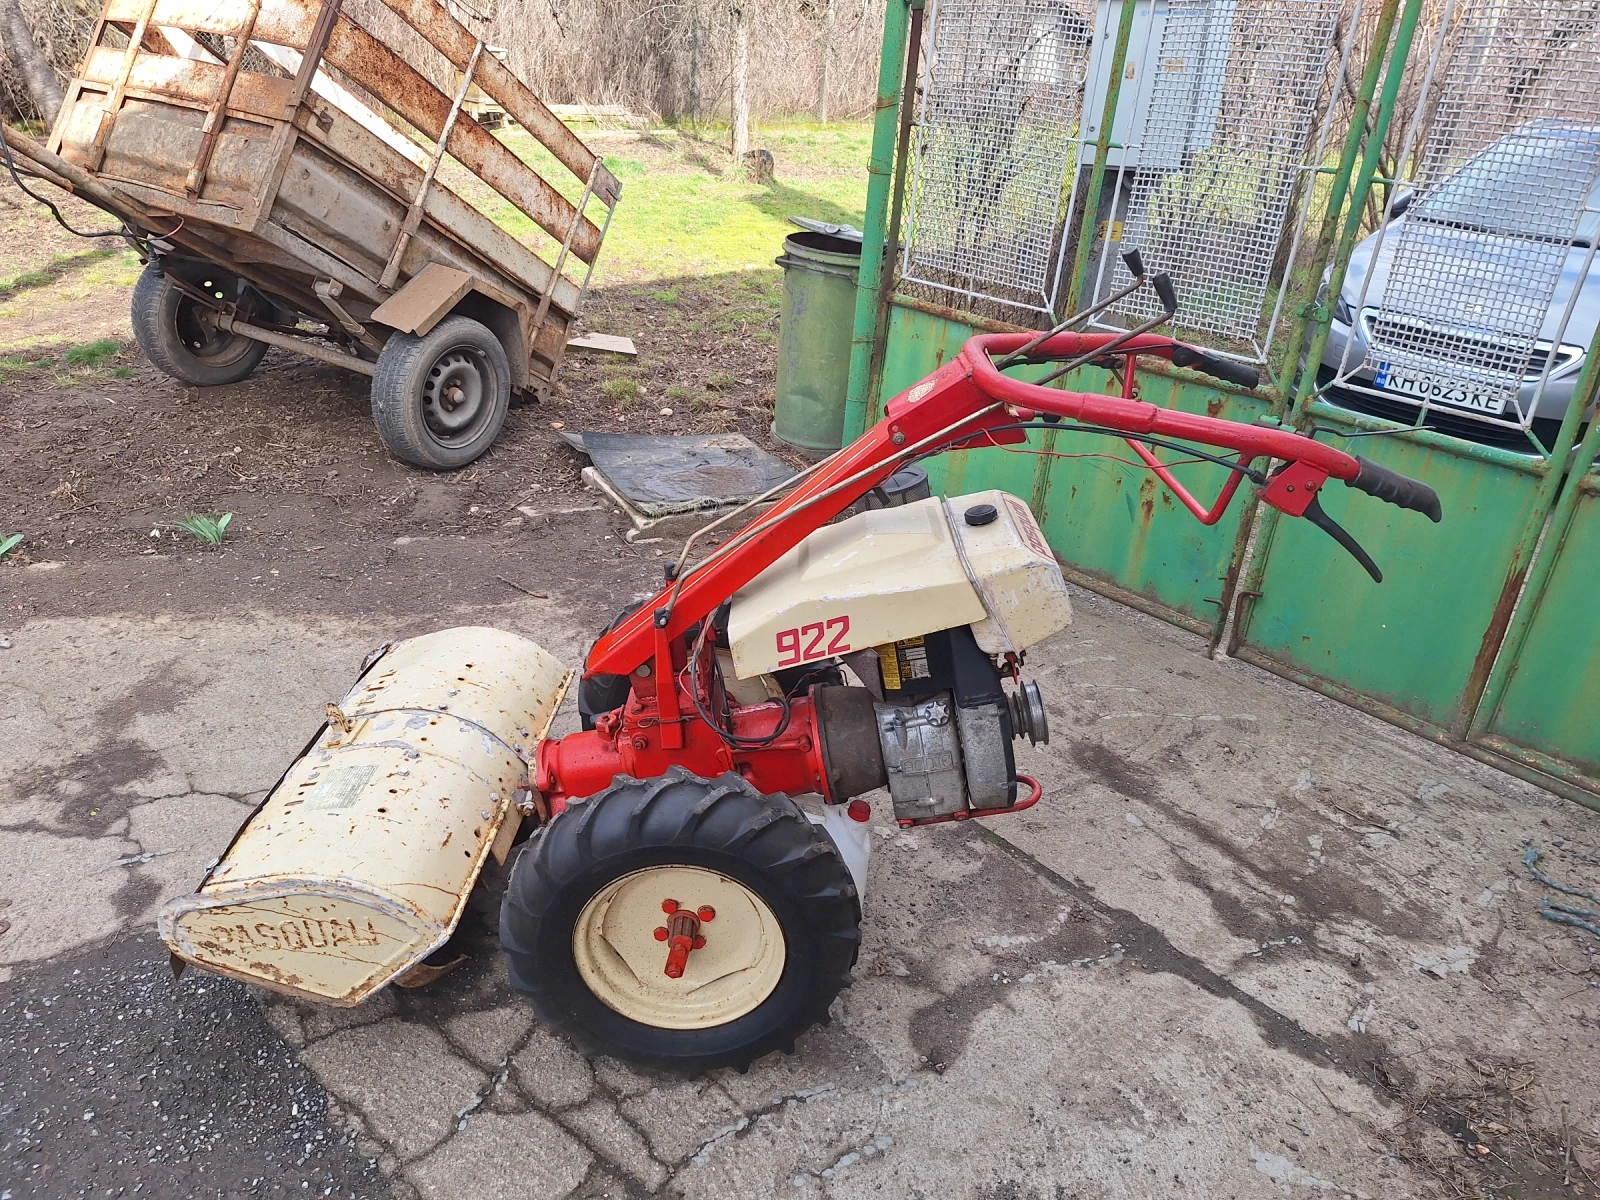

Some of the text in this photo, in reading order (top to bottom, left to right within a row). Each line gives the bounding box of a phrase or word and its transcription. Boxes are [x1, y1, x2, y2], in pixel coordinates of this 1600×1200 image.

[1376, 377, 1386, 385] BG
[776, 615, 850, 667] 922
[210, 917, 380, 951] PASQUALI
